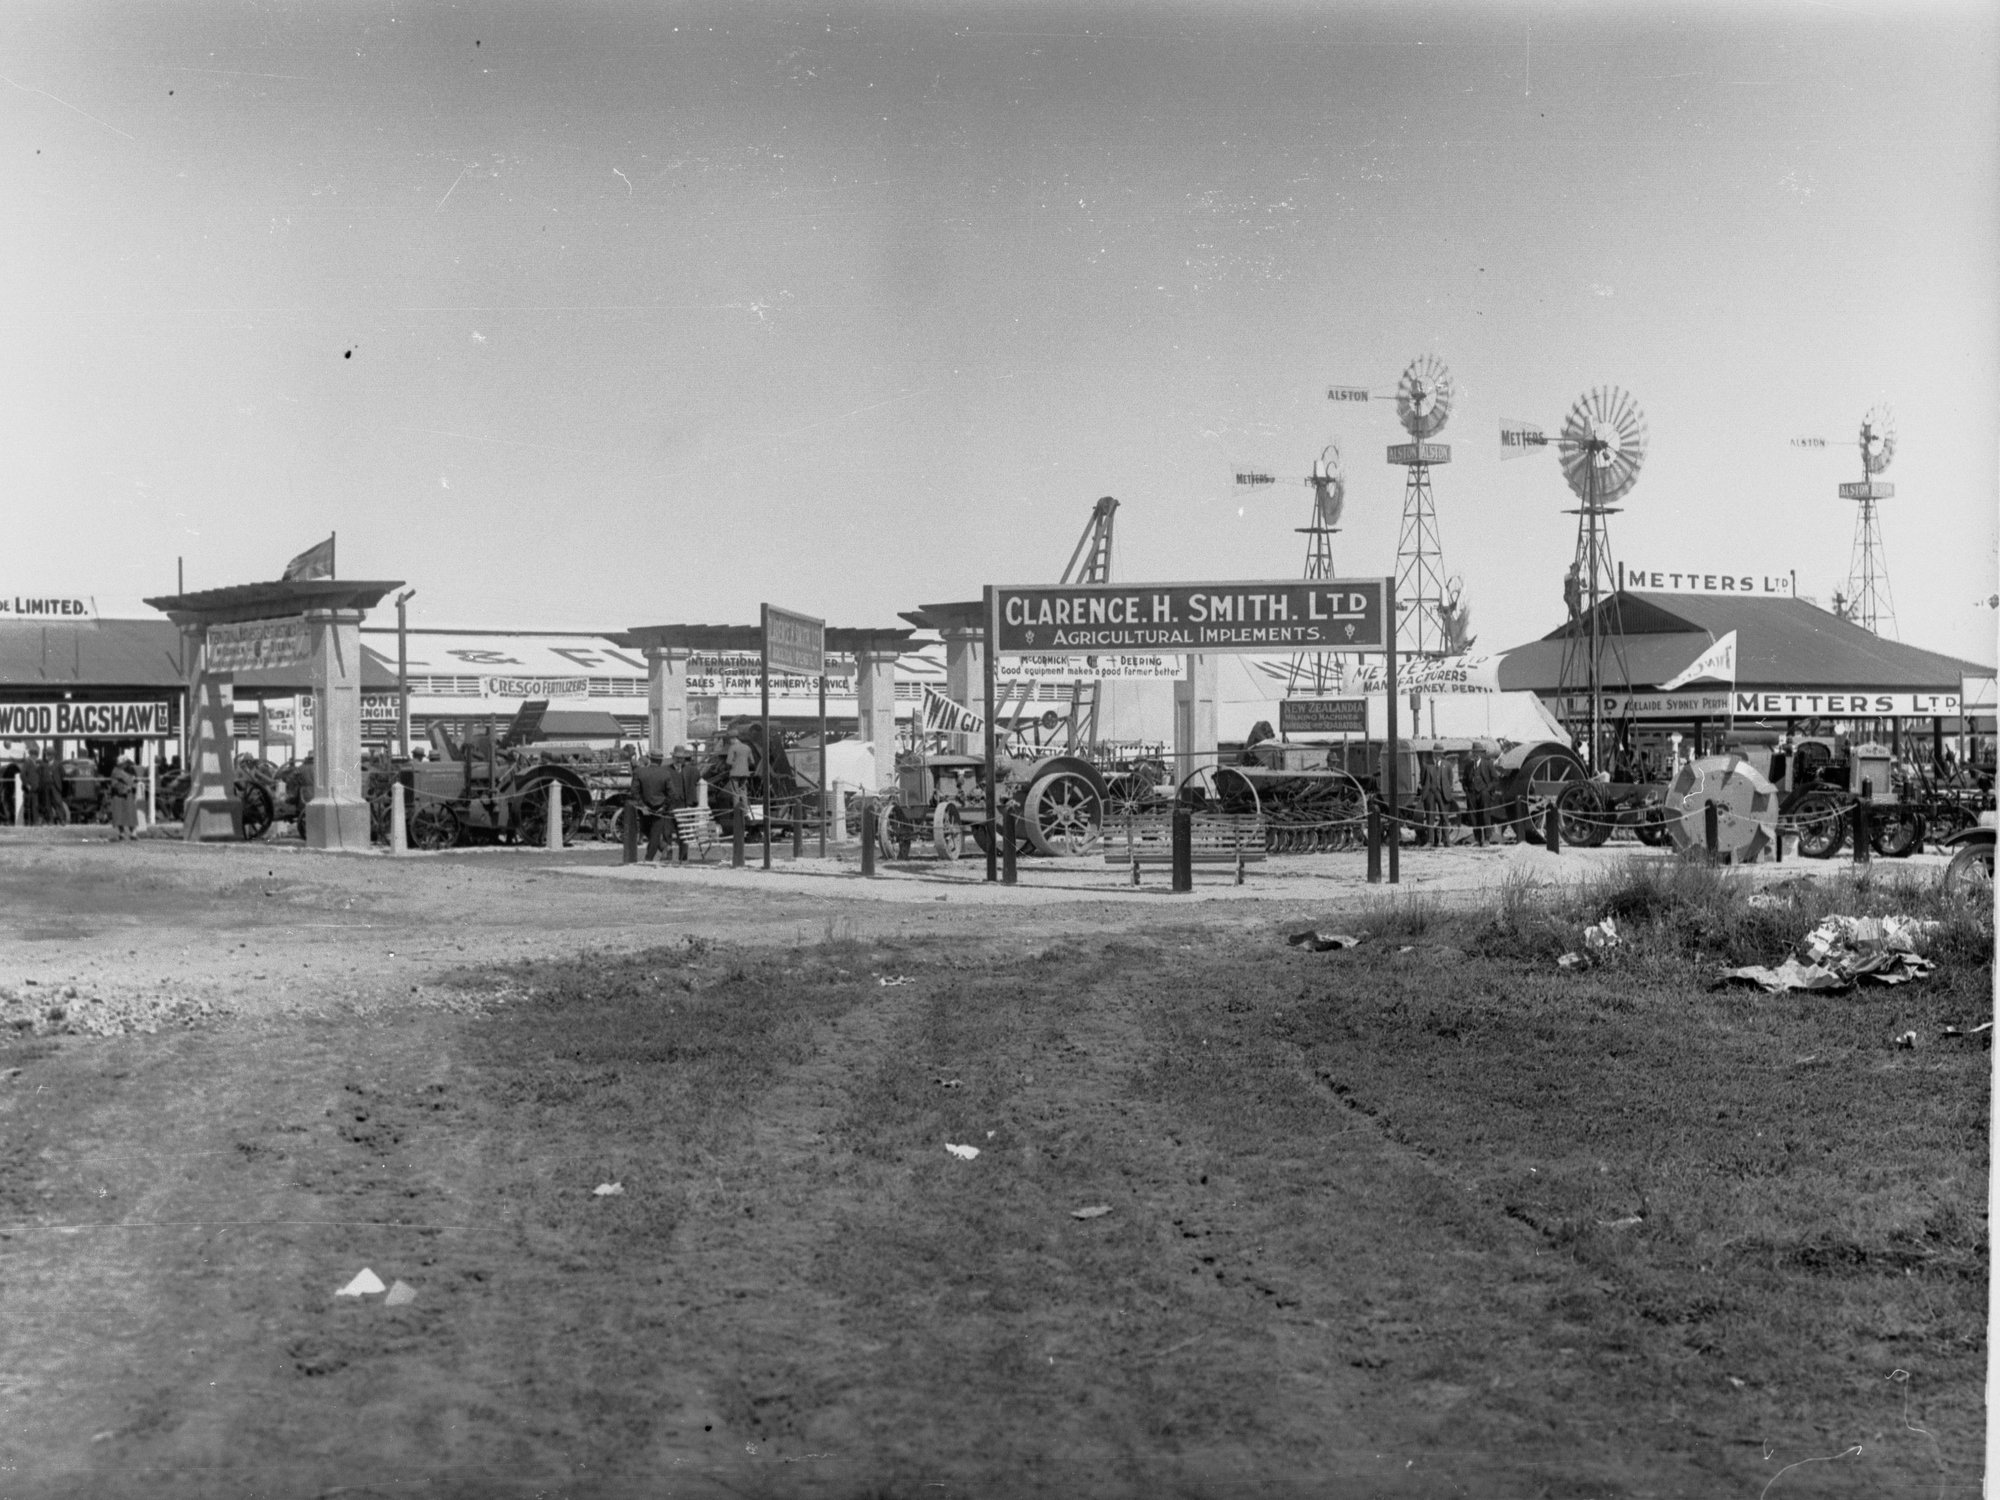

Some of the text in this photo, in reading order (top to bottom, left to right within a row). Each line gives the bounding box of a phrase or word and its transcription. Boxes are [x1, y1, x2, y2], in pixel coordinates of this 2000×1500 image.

[1327, 389, 1369, 402] ALSTON
[1790, 438, 1826, 448] ALSTON
[1388, 446, 1418, 460] ALSTON
[1420, 445, 1449, 461] ALSTON
[1629, 570, 1754, 592] METTERS
[15, 596, 89, 615] LIMITED.
[1309, 591, 1368, 619] LTD
[1052, 626, 1327, 646] AGRICULTURAL IMPLEMENTS.
[687, 657, 763, 668] INTERNATIONA
[1120, 655, 1162, 666] DEERING
[1024, 667, 1064, 677] equipment
[1068, 666, 1093, 675] makes
[1102, 668, 1121, 678] good
[1352, 658, 1446, 683] METERS
[489, 678, 541, 695] CRESGO
[686, 677, 848, 689] SALES FARM MCHINERY SRVICE
[1363, 671, 1468, 693] MANFACTURERS
[923, 688, 960, 730] TWIN
[1284, 702, 1365, 714] NEW ZEALANDIA
[1666, 698, 1699, 711] SYDNEY
[1702, 697, 1729, 710] PERTH
[1736, 693, 1894, 712] METTERS
[57, 703, 154, 734] BAGSHAW
